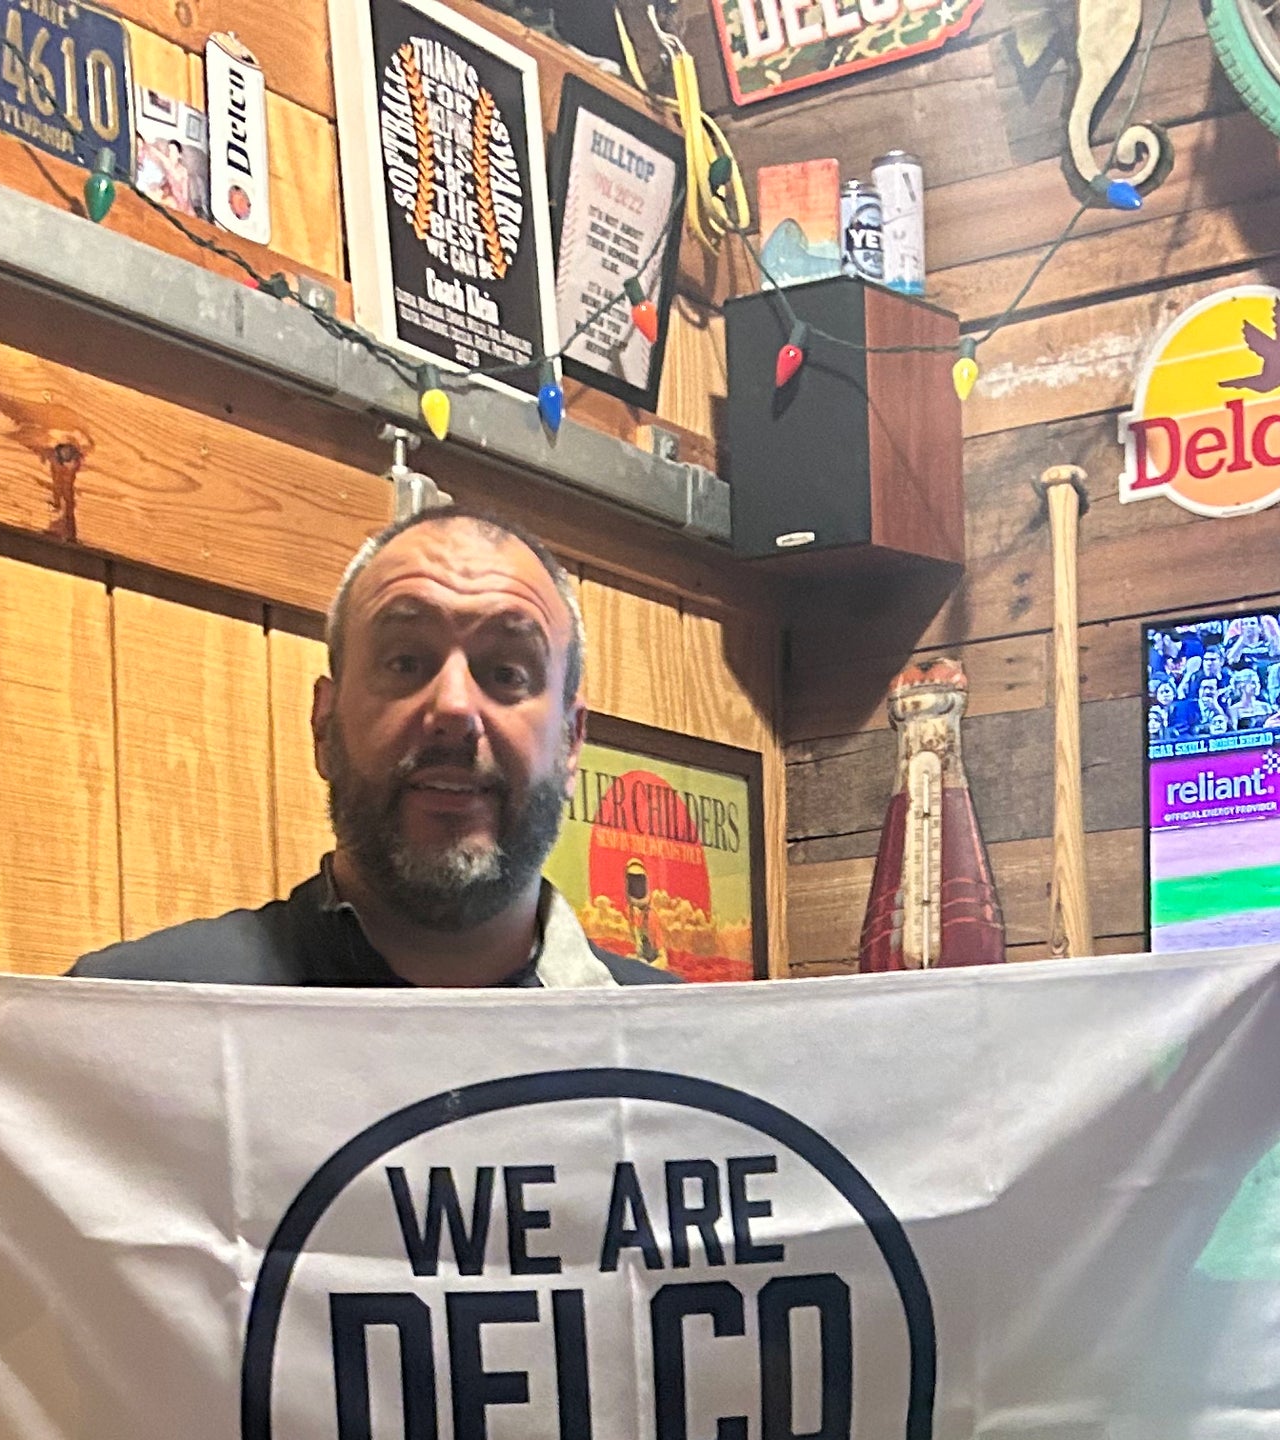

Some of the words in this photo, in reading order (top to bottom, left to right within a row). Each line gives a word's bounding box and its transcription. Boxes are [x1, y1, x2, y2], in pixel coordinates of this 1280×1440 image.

[410, 36, 480, 101] THANKS
[227, 67, 253, 176] Delco
[421, 74, 473, 121] FOR
[381, 66, 419, 213] SOFTBALL
[433, 134, 473, 174] US
[590, 129, 656, 183] HILLTOP
[431, 182, 481, 232] THE
[487, 121, 524, 255] SWARM
[430, 210, 487, 257] BEST
[849, 228, 883, 249] YE
[1175, 739, 1208, 755] SKULL
[630, 780, 741, 853] CHILDERS
[1164, 810, 1202, 823] OFFICIAL
[385, 1164, 562, 1276] WE
[599, 1155, 784, 1273] ARE
